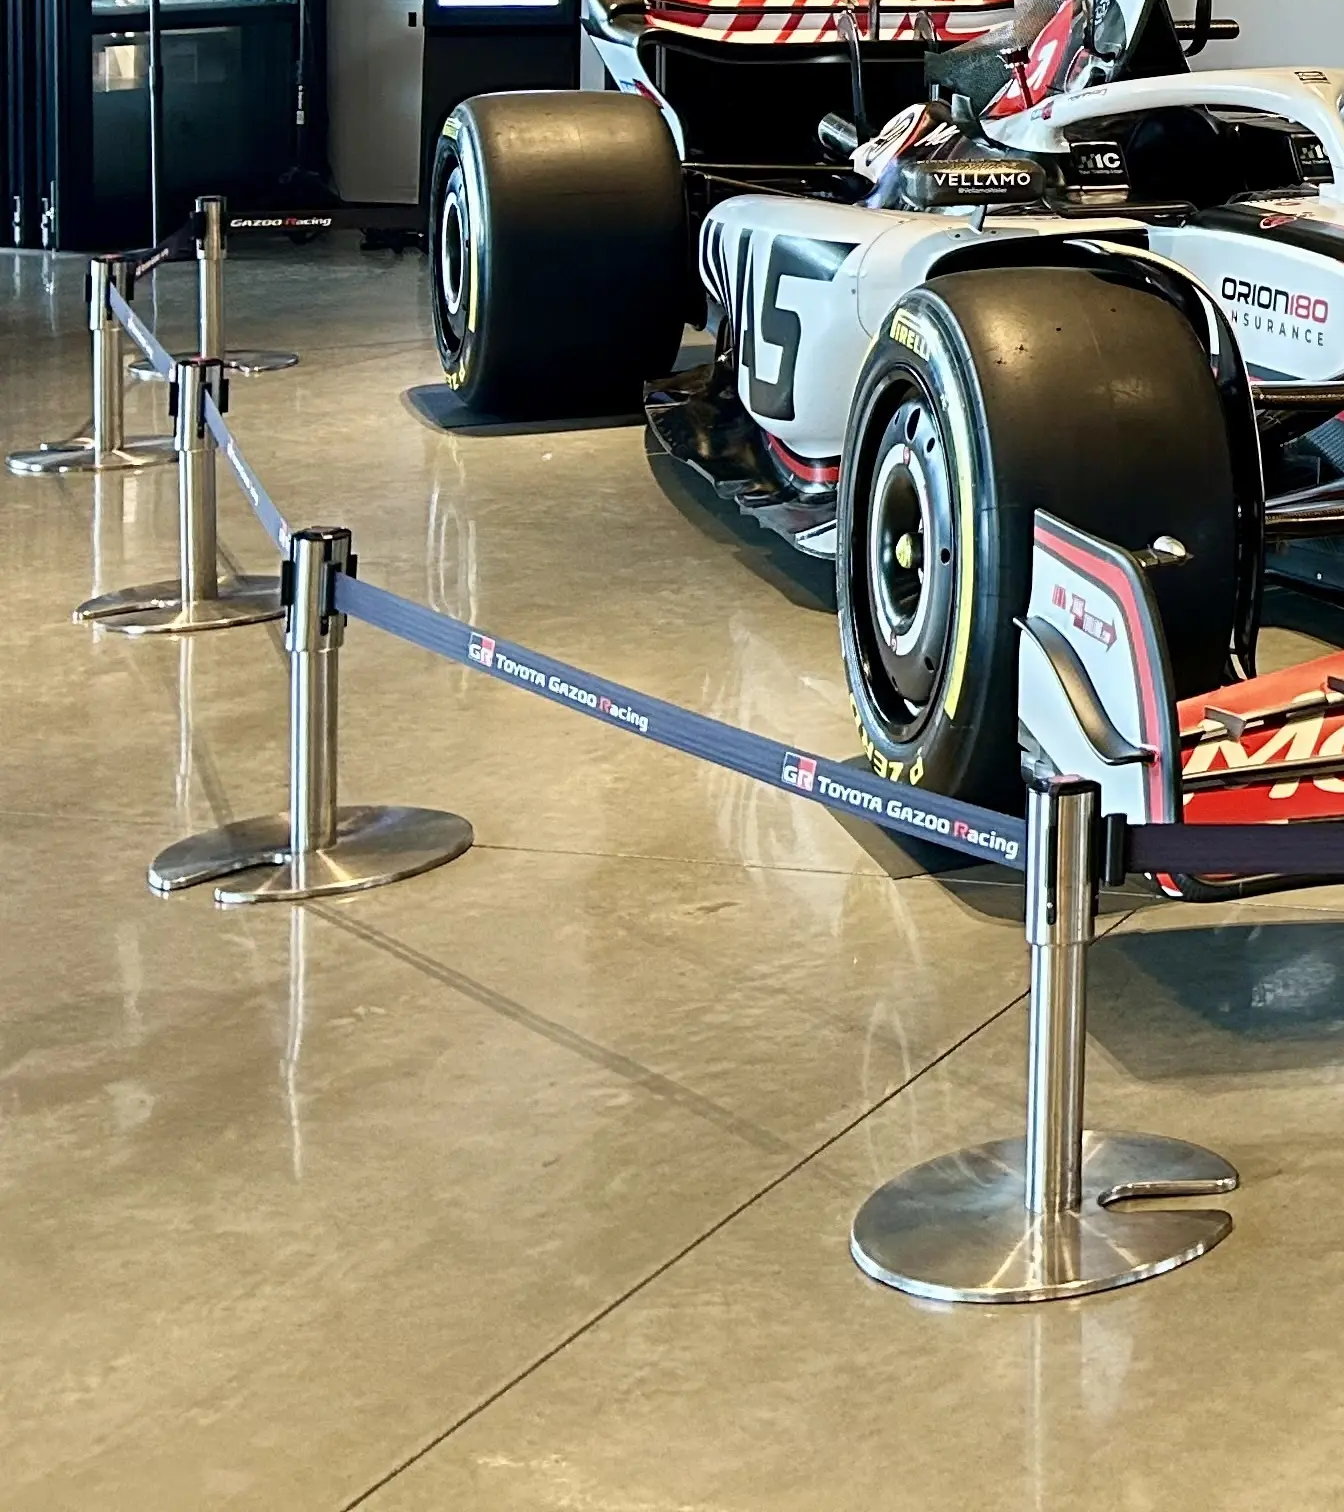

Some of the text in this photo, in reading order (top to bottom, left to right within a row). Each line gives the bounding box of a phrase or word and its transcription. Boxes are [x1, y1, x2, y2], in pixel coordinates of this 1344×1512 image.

[934, 172, 1031, 186] VELLAMO
[1231, 310, 1324, 347] NSURANCE
[469, 638, 649, 733] GR TOYOTA GAZOO Racing
[782, 759, 1019, 860] GR TOYOTA GAZOO Racing
